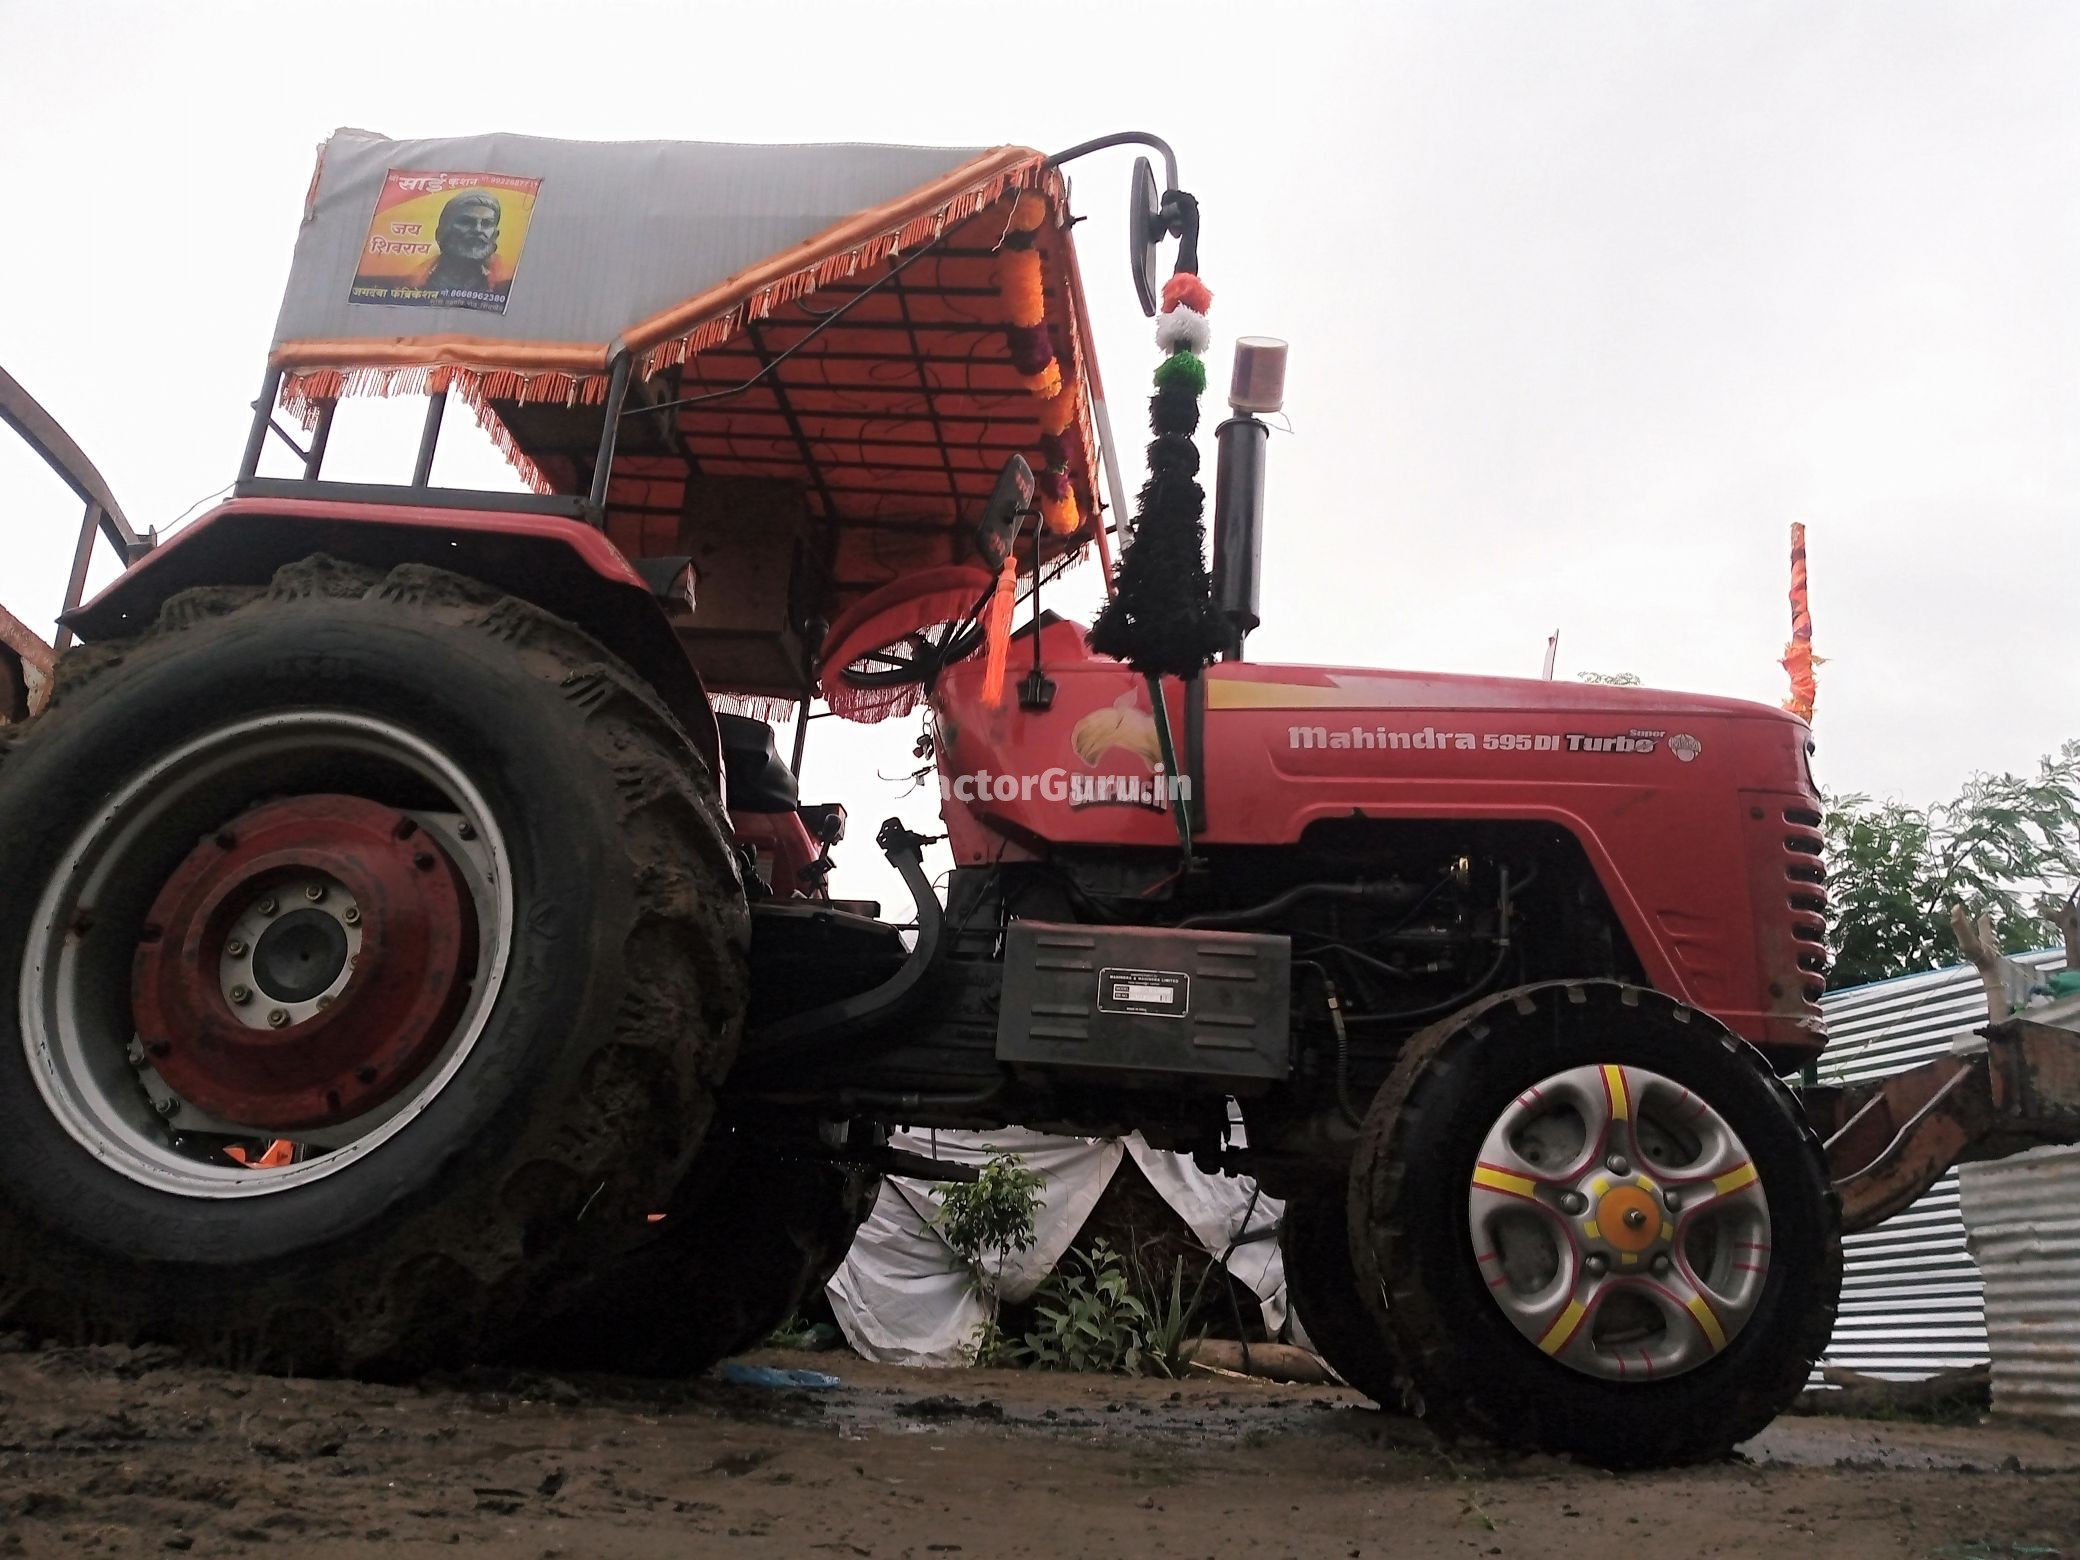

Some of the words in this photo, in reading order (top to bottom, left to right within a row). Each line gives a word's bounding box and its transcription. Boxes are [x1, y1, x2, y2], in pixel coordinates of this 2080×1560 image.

[390, 222, 422, 236] जय
[370, 237, 432, 254] शिवराय
[1288, 726, 1476, 750] Mahindra
[1566, 734, 1656, 754] Turbo
